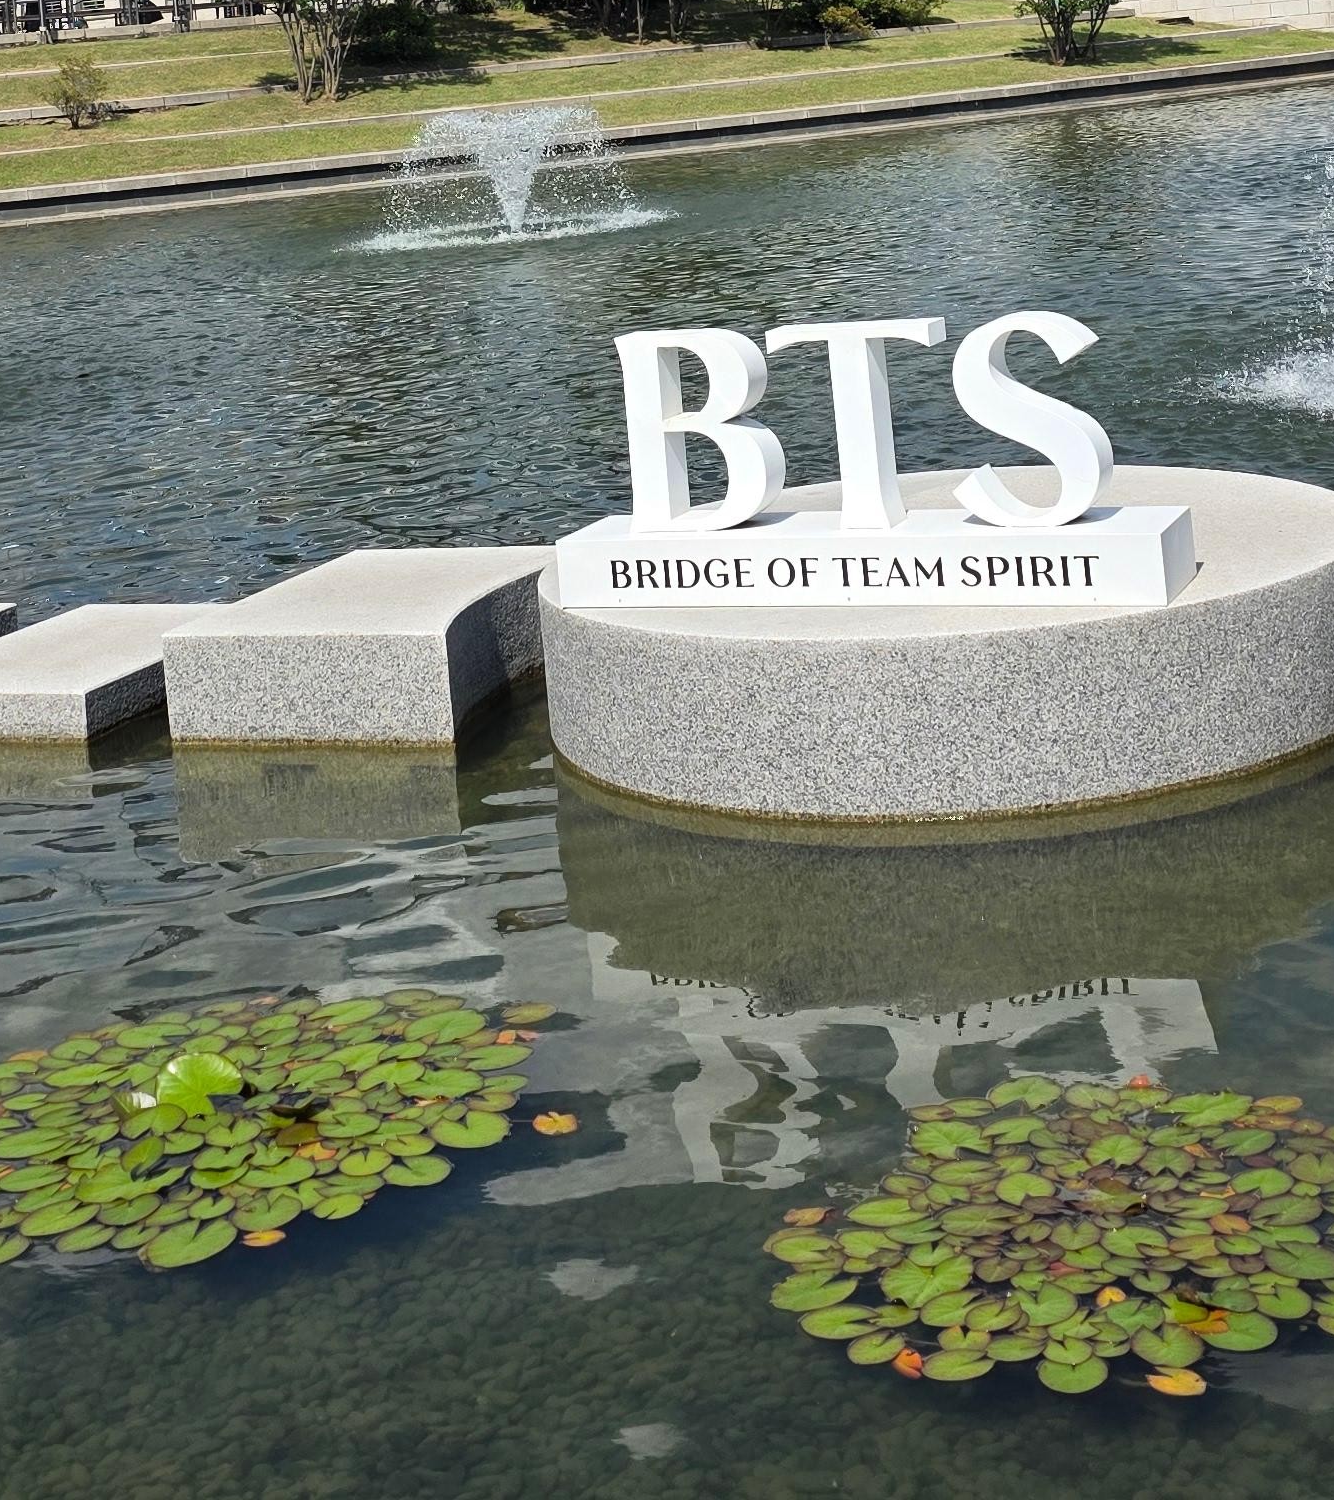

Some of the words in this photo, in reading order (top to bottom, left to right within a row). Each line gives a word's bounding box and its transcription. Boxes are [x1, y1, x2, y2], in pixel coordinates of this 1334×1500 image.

[614, 311, 1114, 532] BTS
[610, 558, 755, 589] BRIDGE
[767, 556, 819, 588] OF
[832, 556, 946, 588] TEAM
[960, 555, 1100, 588] SPIRIT
